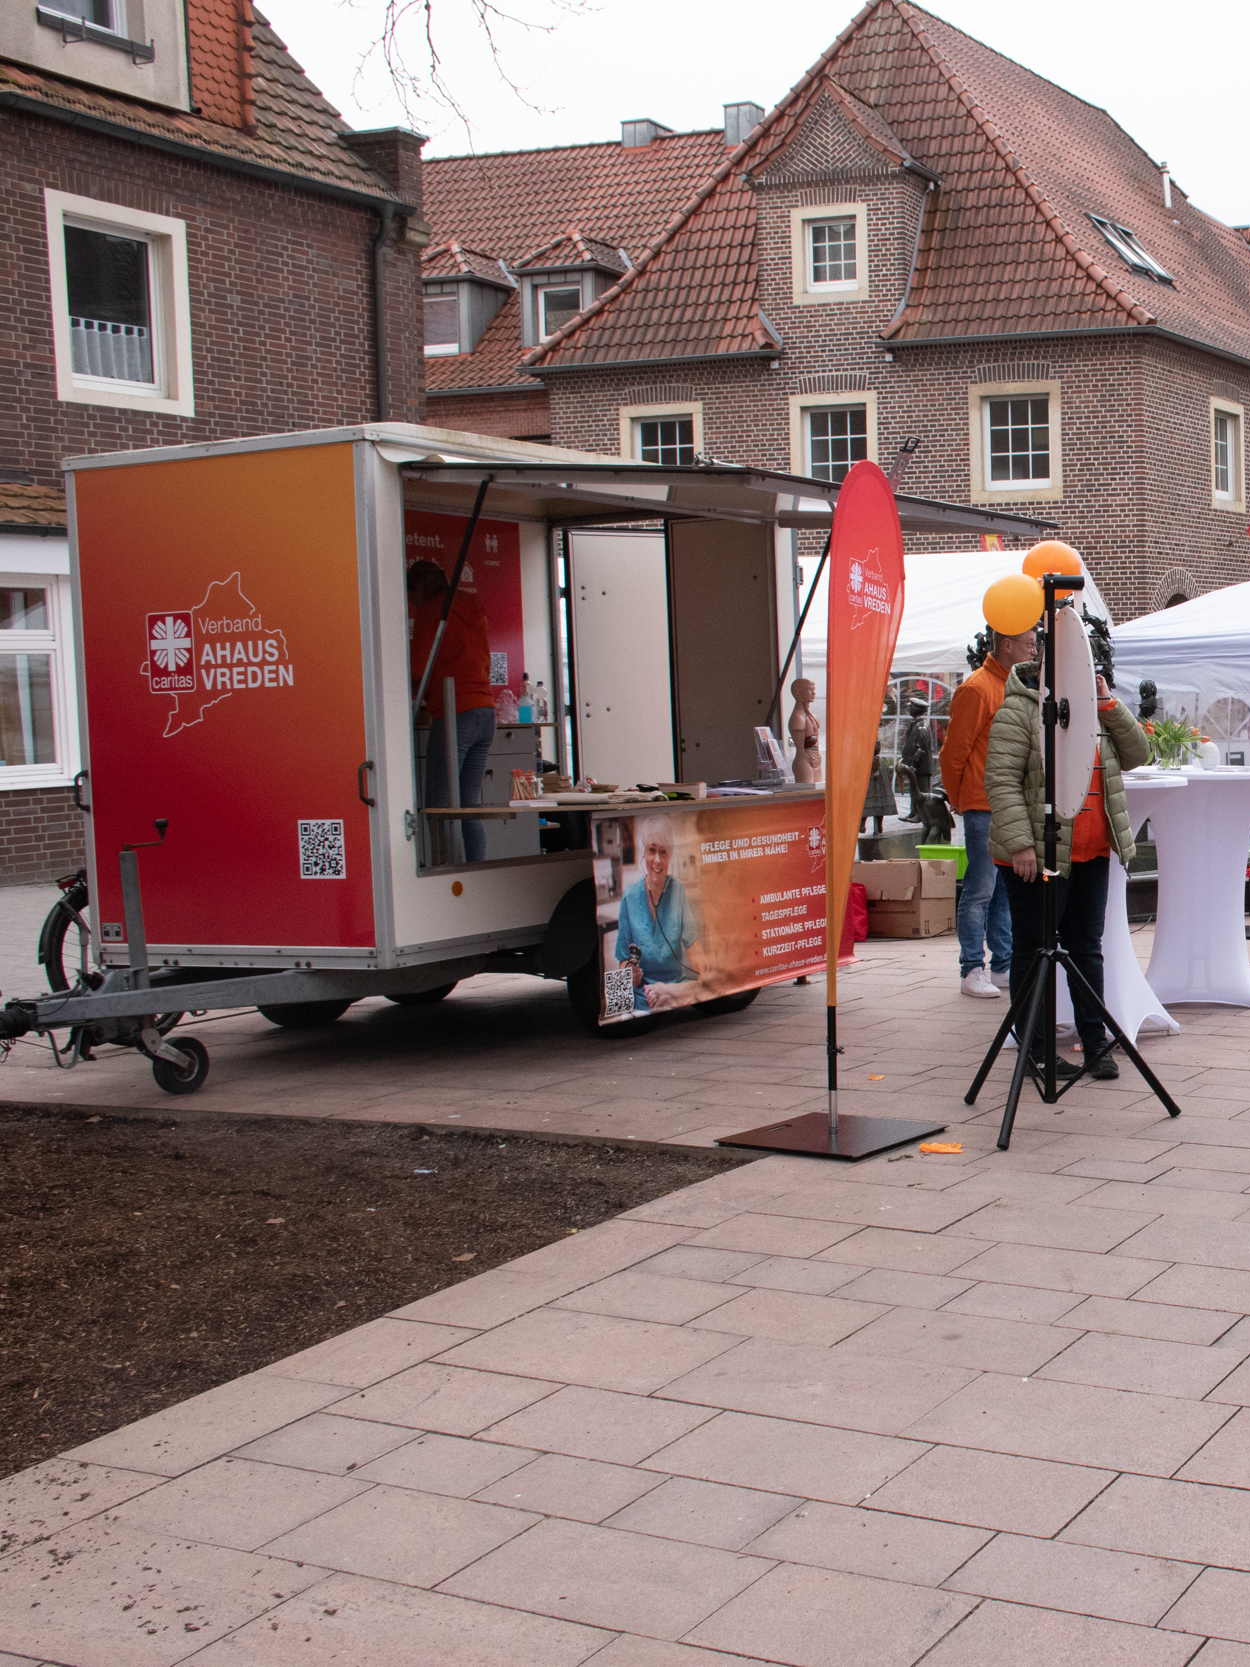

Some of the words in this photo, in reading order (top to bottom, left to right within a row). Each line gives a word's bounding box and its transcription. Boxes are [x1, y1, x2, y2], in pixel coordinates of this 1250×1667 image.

[405, 532, 445, 549] etent.
[865, 567, 884, 582] Verband
[864, 582, 887, 600] AHAUS
[864, 595, 891, 615] VREDEN
[198, 614, 262, 634] Verband
[200, 639, 279, 665] AHAUS
[152, 673, 193, 689] caritas
[201, 664, 294, 690] VREDEN
[701, 840, 731, 853] PFLEGE
[732, 838, 749, 849] UND
[751, 832, 800, 846] GESUNDHEIT
[702, 852, 728, 864] IMMER
[730, 851, 738, 861] IN
[740, 848, 763, 859] IHRER
[765, 844, 788, 855] NÄHE!
[760, 888, 800, 904] AMBULANTE
[802, 884, 827, 897] PFLEGE
[761, 905, 807, 922] TAGESPFLEGE
[761, 922, 803, 940] STATIONÄRE
[763, 936, 822, 957] KURZZEIT-PFLEGE
[755, 953, 827, 976] www.caritas-ahaus-vreden.d
